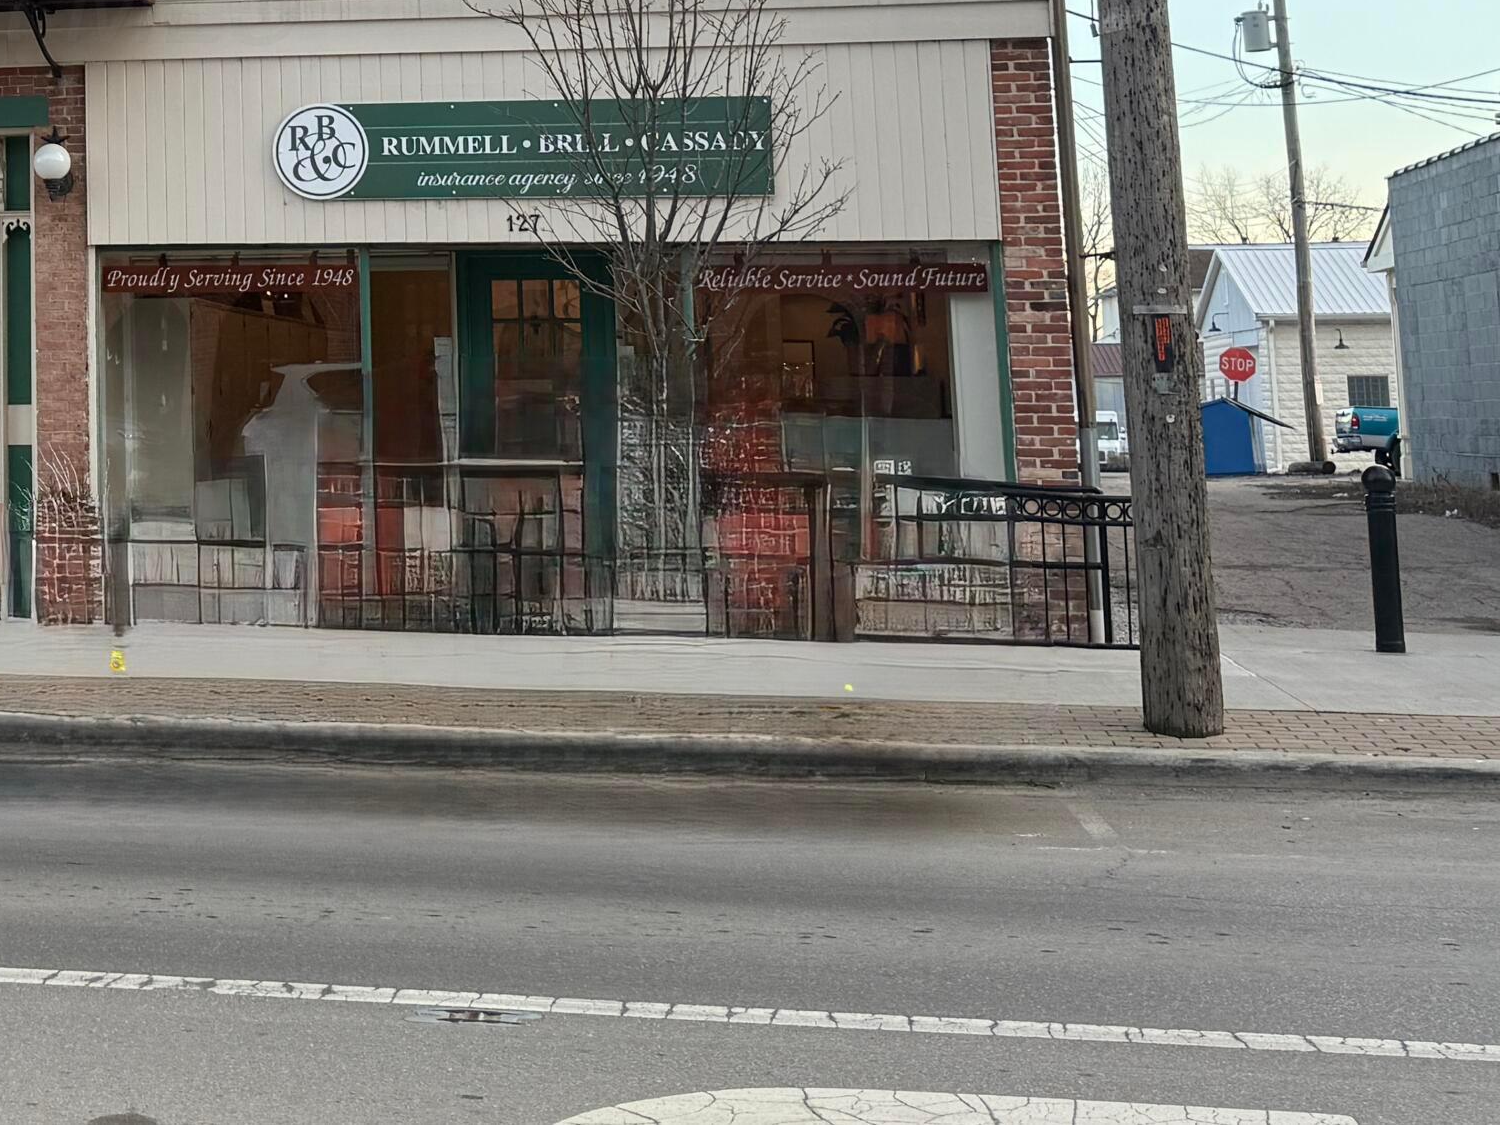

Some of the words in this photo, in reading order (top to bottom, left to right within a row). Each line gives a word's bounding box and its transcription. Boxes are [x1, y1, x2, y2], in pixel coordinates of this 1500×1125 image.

[381, 135, 517, 156] RUMMELL
[417, 171, 506, 186] insurance
[508, 173, 578, 195] agency
[506, 214, 540, 232] 127
[107, 267, 179, 292] Proudly
[184, 269, 253, 292] Serving
[257, 268, 304, 287] Since
[311, 268, 353, 286] 1948
[699, 267, 771, 291] Reliable
[774, 269, 842, 289] Service
[853, 265, 921, 289] Sound
[919, 267, 985, 289] Future
[1221, 357, 1254, 372] STOP
